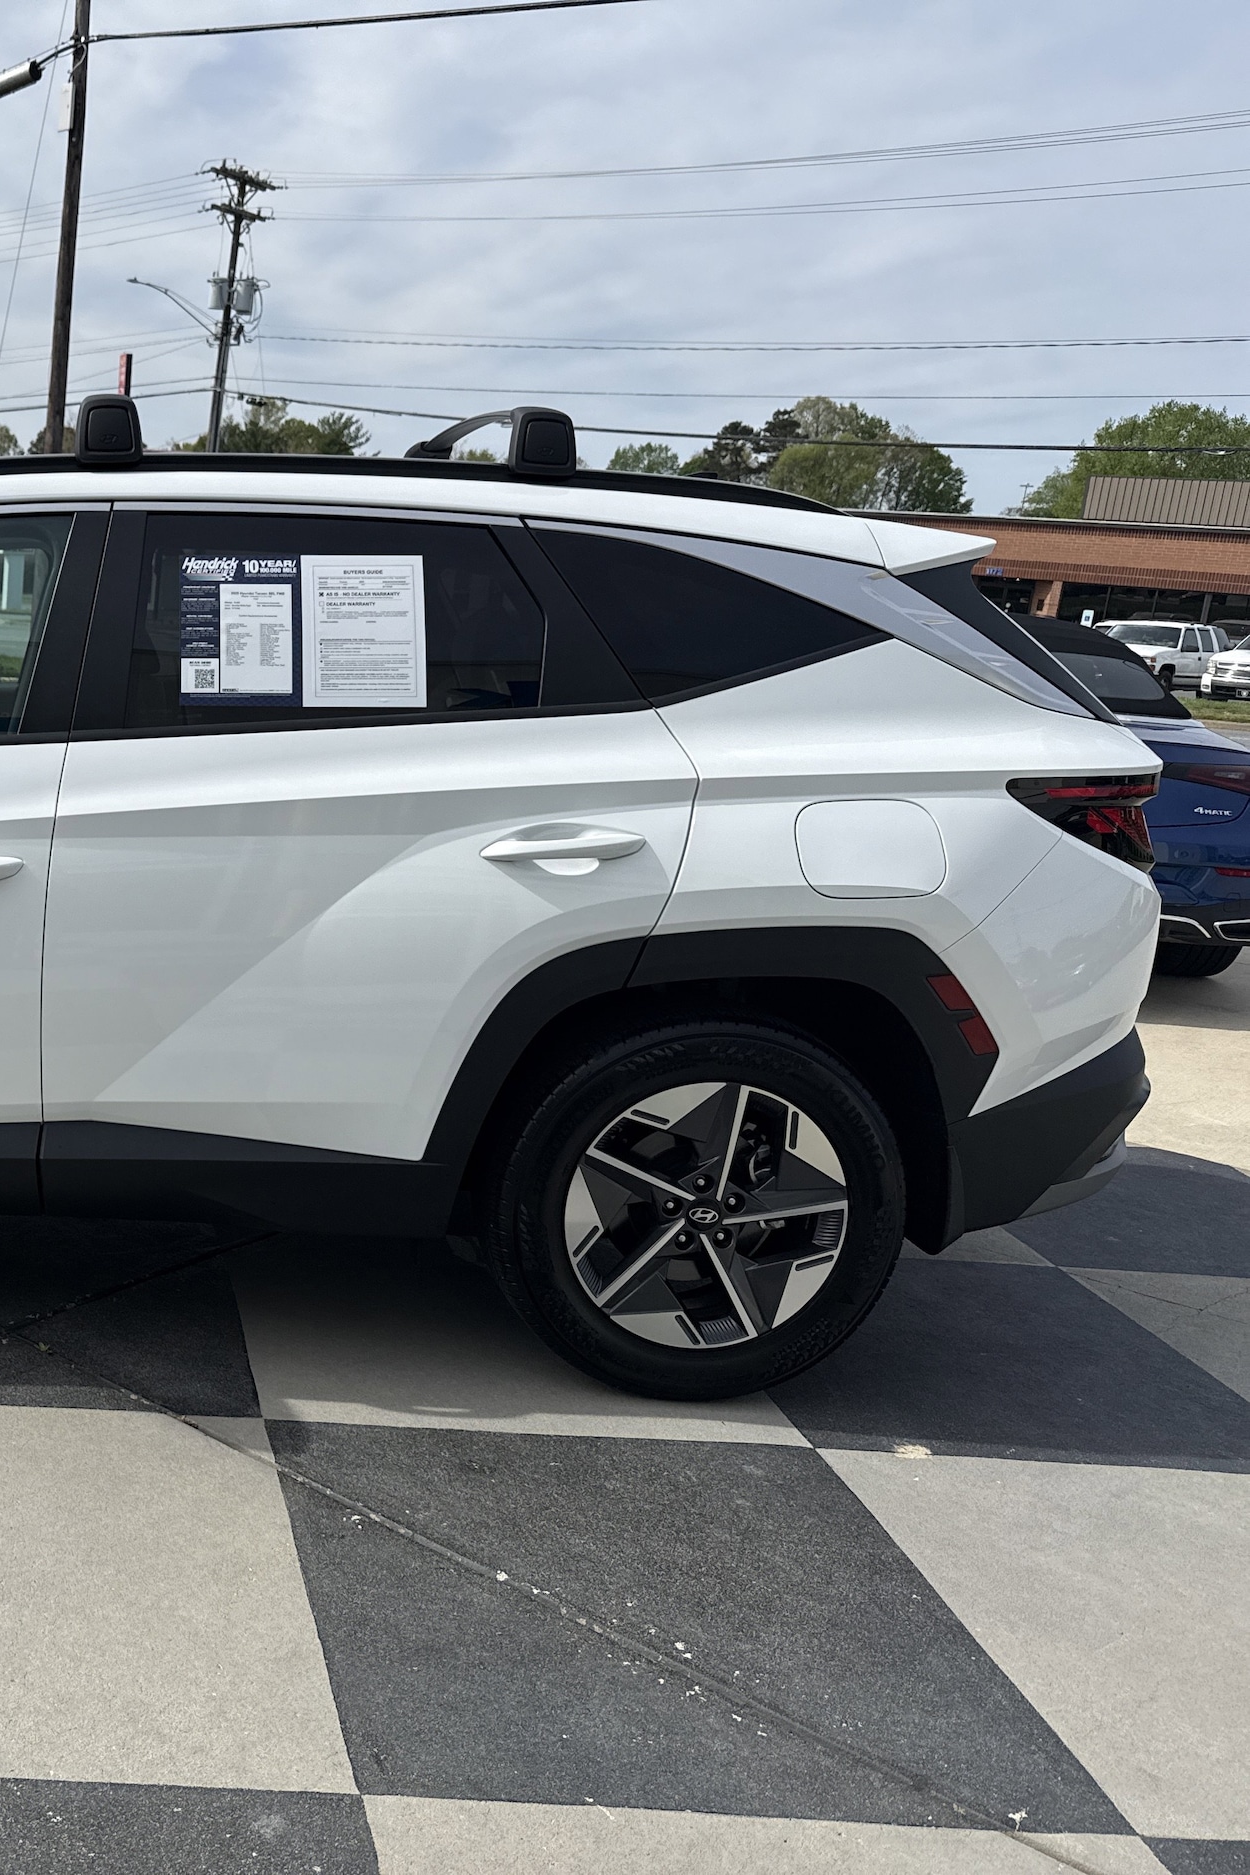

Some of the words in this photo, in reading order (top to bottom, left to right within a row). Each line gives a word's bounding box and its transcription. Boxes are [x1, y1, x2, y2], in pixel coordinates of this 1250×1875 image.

[182, 557, 239, 573] Hendrick
[242, 560, 259, 573] 10
[1194, 807, 1232, 816] 4MATIC
